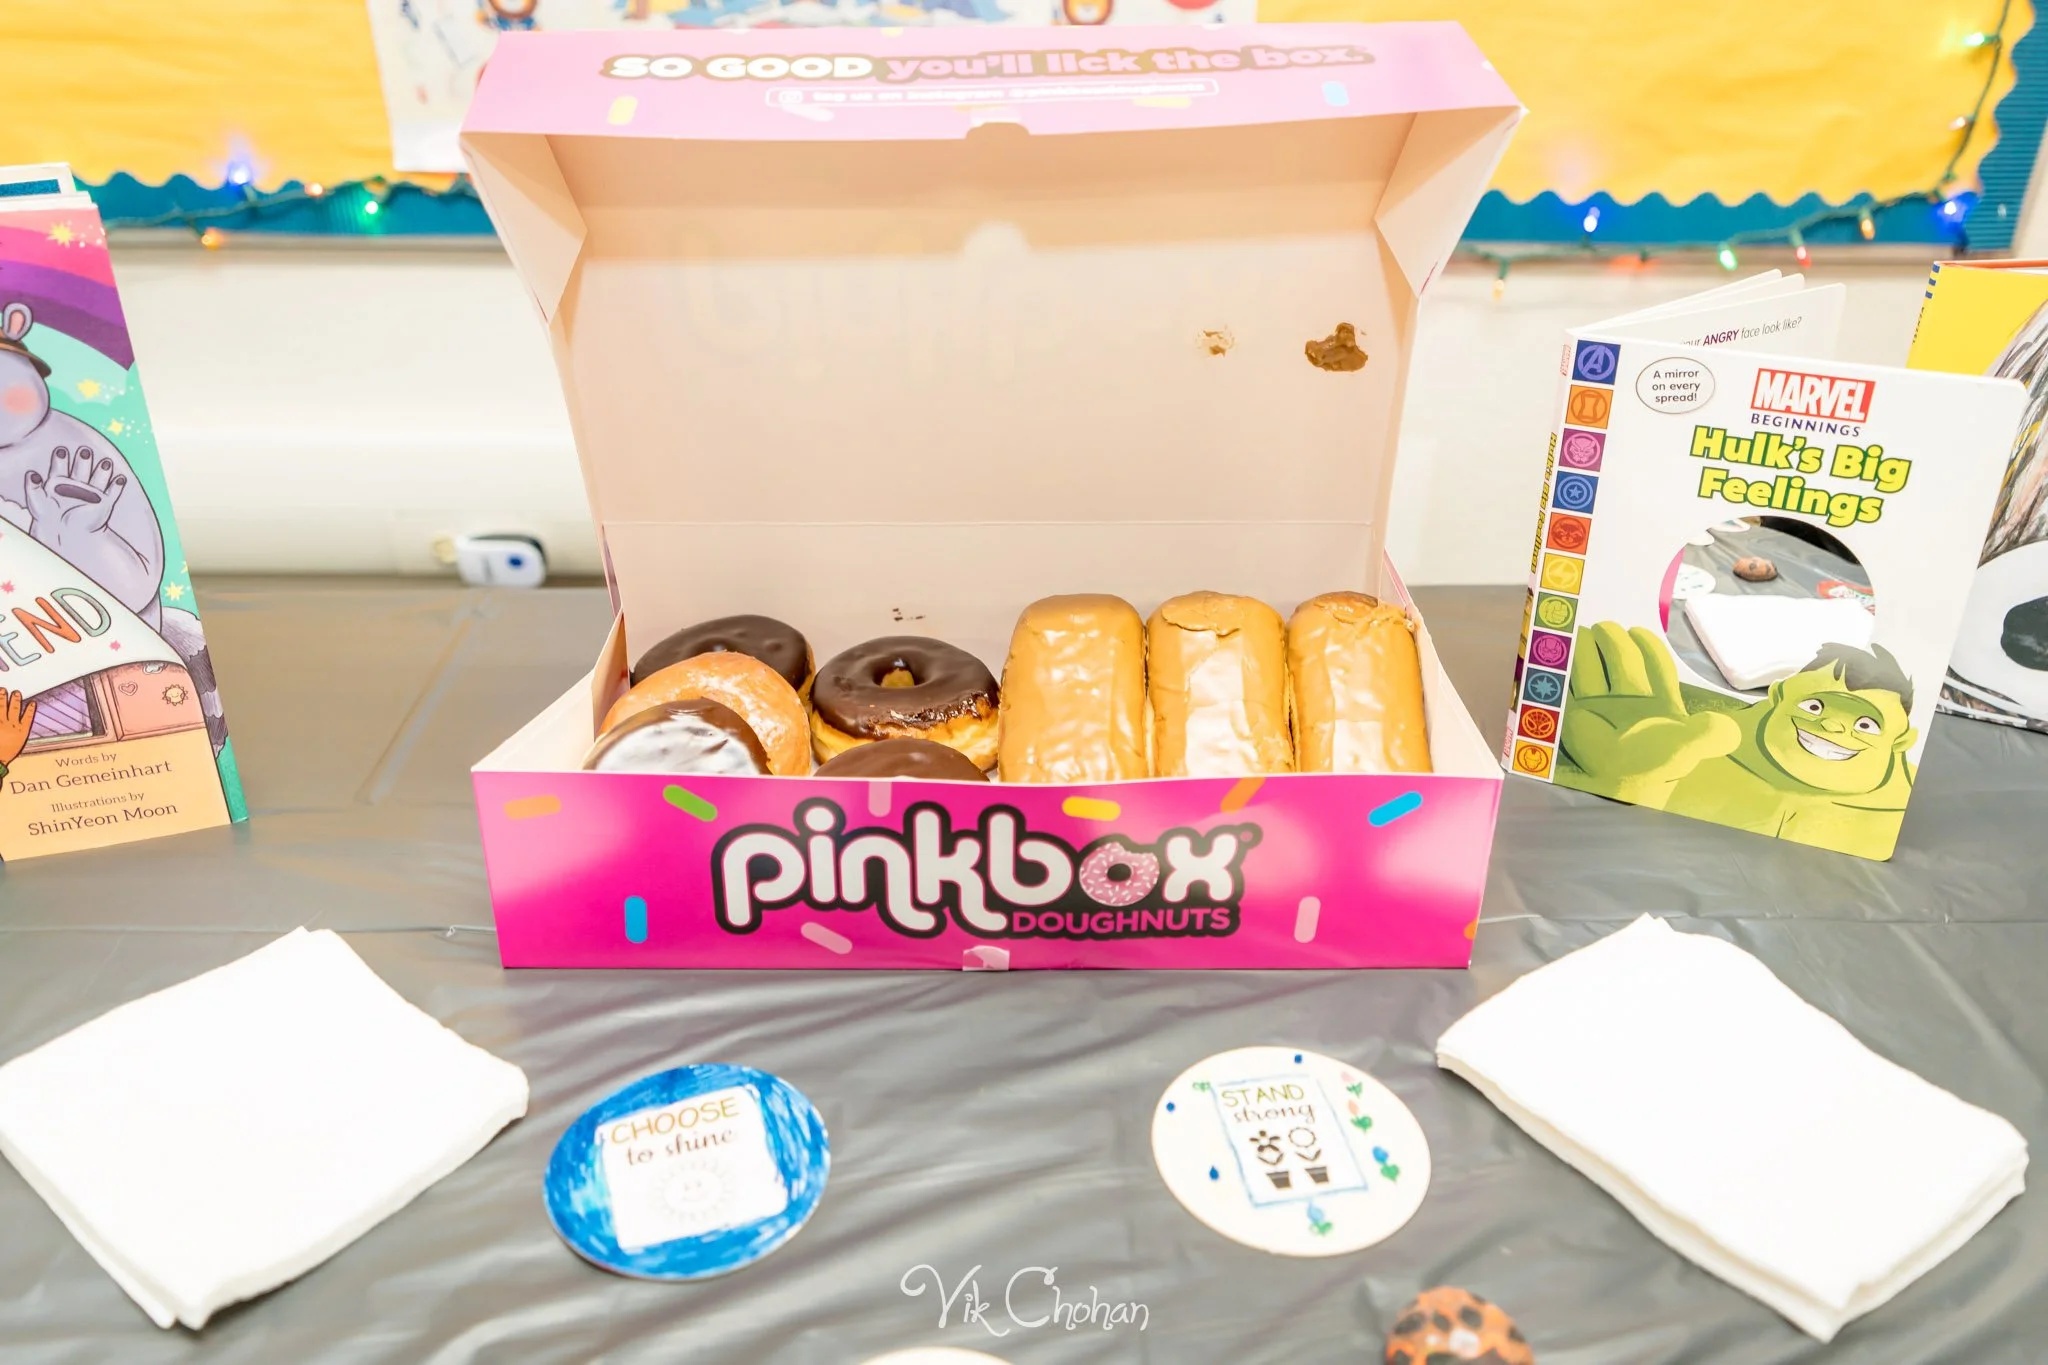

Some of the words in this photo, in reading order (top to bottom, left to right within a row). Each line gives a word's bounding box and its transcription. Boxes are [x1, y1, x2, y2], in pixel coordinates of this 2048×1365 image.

[604, 55, 693, 79] SO
[706, 55, 873, 79] GOOD
[884, 52, 1033, 80] you'll
[1046, 50, 1140, 73] lick
[1151, 48, 1241, 71] the
[1251, 45, 1366, 68] box.
[1703, 329, 1740, 347] ANGRY
[1740, 327, 1760, 339] face
[1762, 320, 1780, 335] look
[1782, 316, 1802, 331] like?
[1652, 383, 1666, 391] on
[1669, 382, 1701, 393] every
[1653, 370, 1662, 379] A
[1664, 370, 1700, 379] mirror
[1655, 393, 1698, 404] spread!
[1752, 369, 1870, 421] MARVEL
[1751, 413, 1861, 437] BEGINNINGS
[1690, 425, 1824, 474] Hulk's
[1830, 445, 1911, 494] Big
[1697, 465, 1884, 527] Feelings
[0, 587, 112, 673] END
[55, 754, 99, 768] Words
[102, 751, 118, 764] by
[10, 778, 51, 795] Dan
[56, 760, 173, 789] Gemeinhart
[28, 813, 118, 837] ShinYeon
[124, 801, 179, 823] Moon
[51, 793, 127, 814] Illustrations
[128, 791, 145, 803] by
[716, 801, 1242, 935] pinkbox
[1013, 907, 1231, 934] DOUGHNUTS
[1221, 1084, 1306, 1108] STAND
[611, 1097, 740, 1146] CHOOSE
[1233, 1103, 1316, 1124] strong
[625, 1147, 655, 1166] to
[665, 1129, 738, 1157] shine
